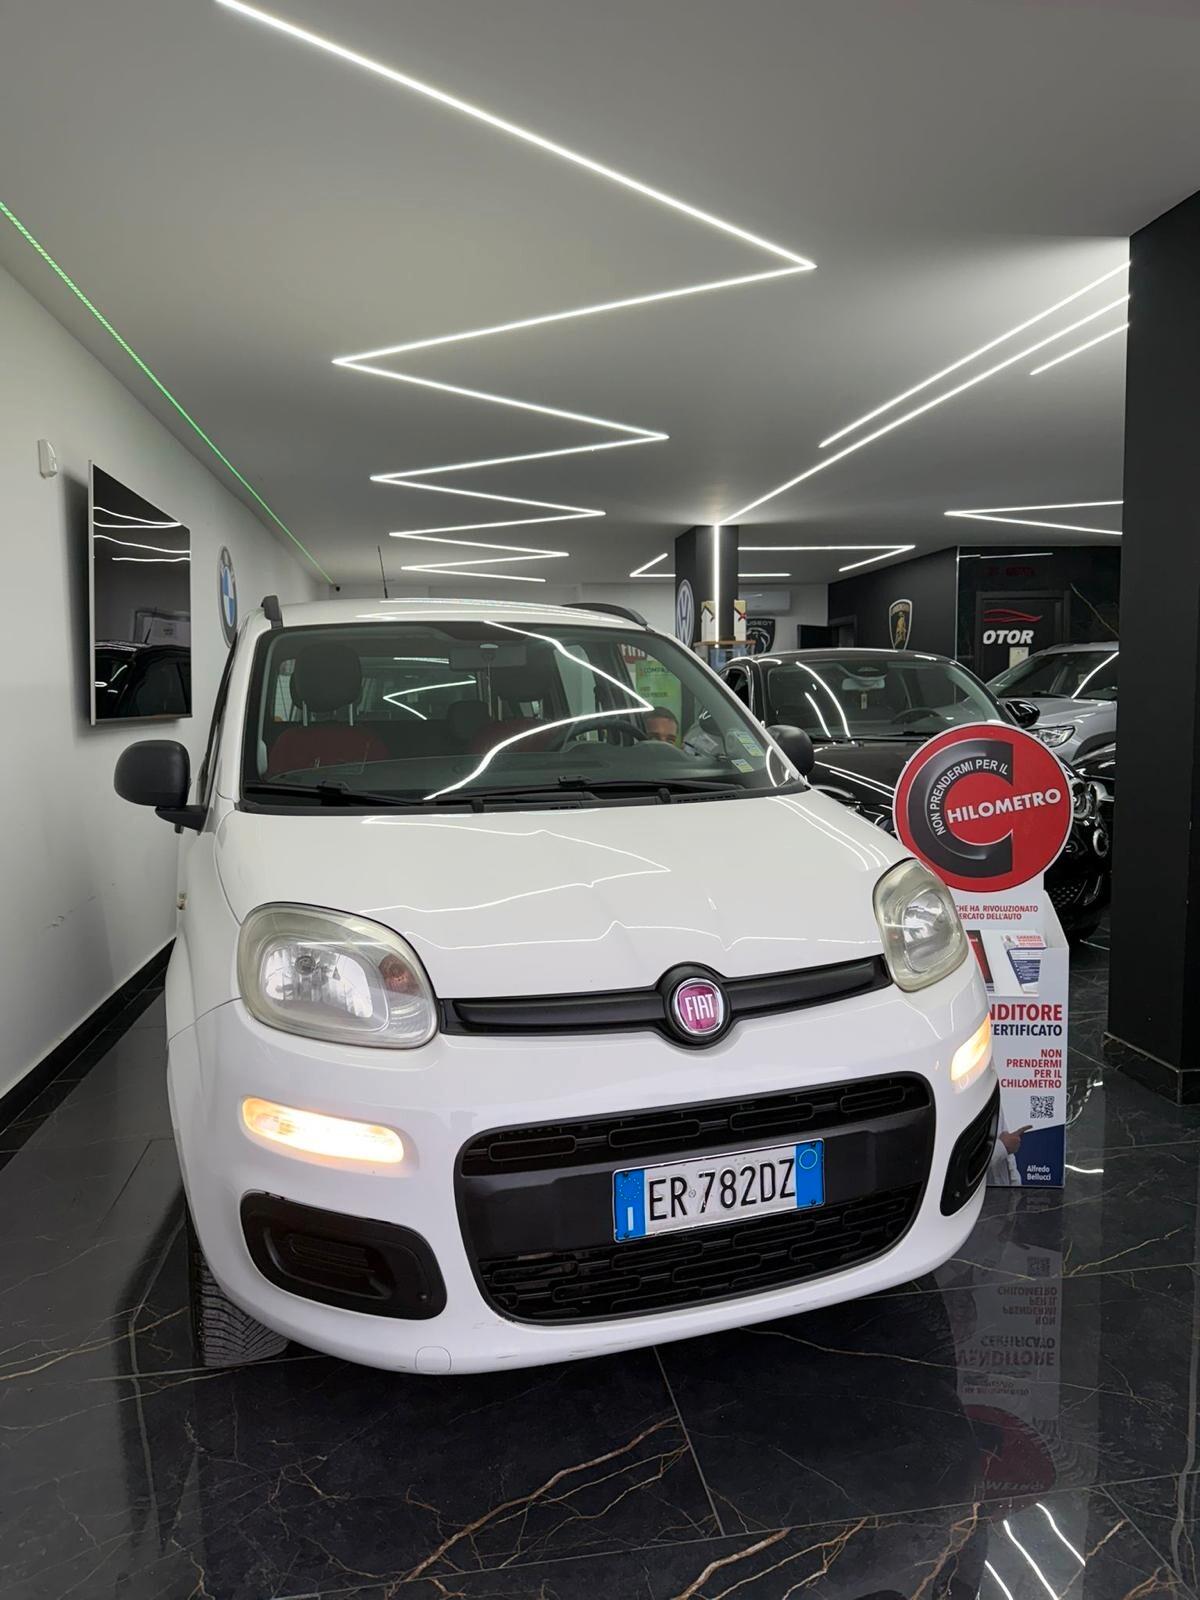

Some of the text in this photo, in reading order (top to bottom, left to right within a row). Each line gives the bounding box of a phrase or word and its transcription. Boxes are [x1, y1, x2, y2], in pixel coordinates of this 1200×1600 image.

[983, 629, 1034, 645] OTOR
[929, 759, 1009, 837] NON PRENDERMI PER IL
[946, 788, 1062, 824] HILOMETRO
[982, 905, 1039, 913] RIVOLUZIONATO
[684, 993, 715, 1022] FIAT
[990, 1004, 1063, 1021] NDITORE
[991, 1024, 1063, 1036] ERTIFICATO
[1040, 1049, 1062, 1058] NON
[1006, 1059, 1062, 1068] PRENDERMI
[1034, 1069, 1062, 1078] PER IL
[1000, 1079, 1062, 1088] CHILOMETRO
[1026, 1165, 1050, 1173] Alfredo
[1026, 1173, 1052, 1181] Bellucci
